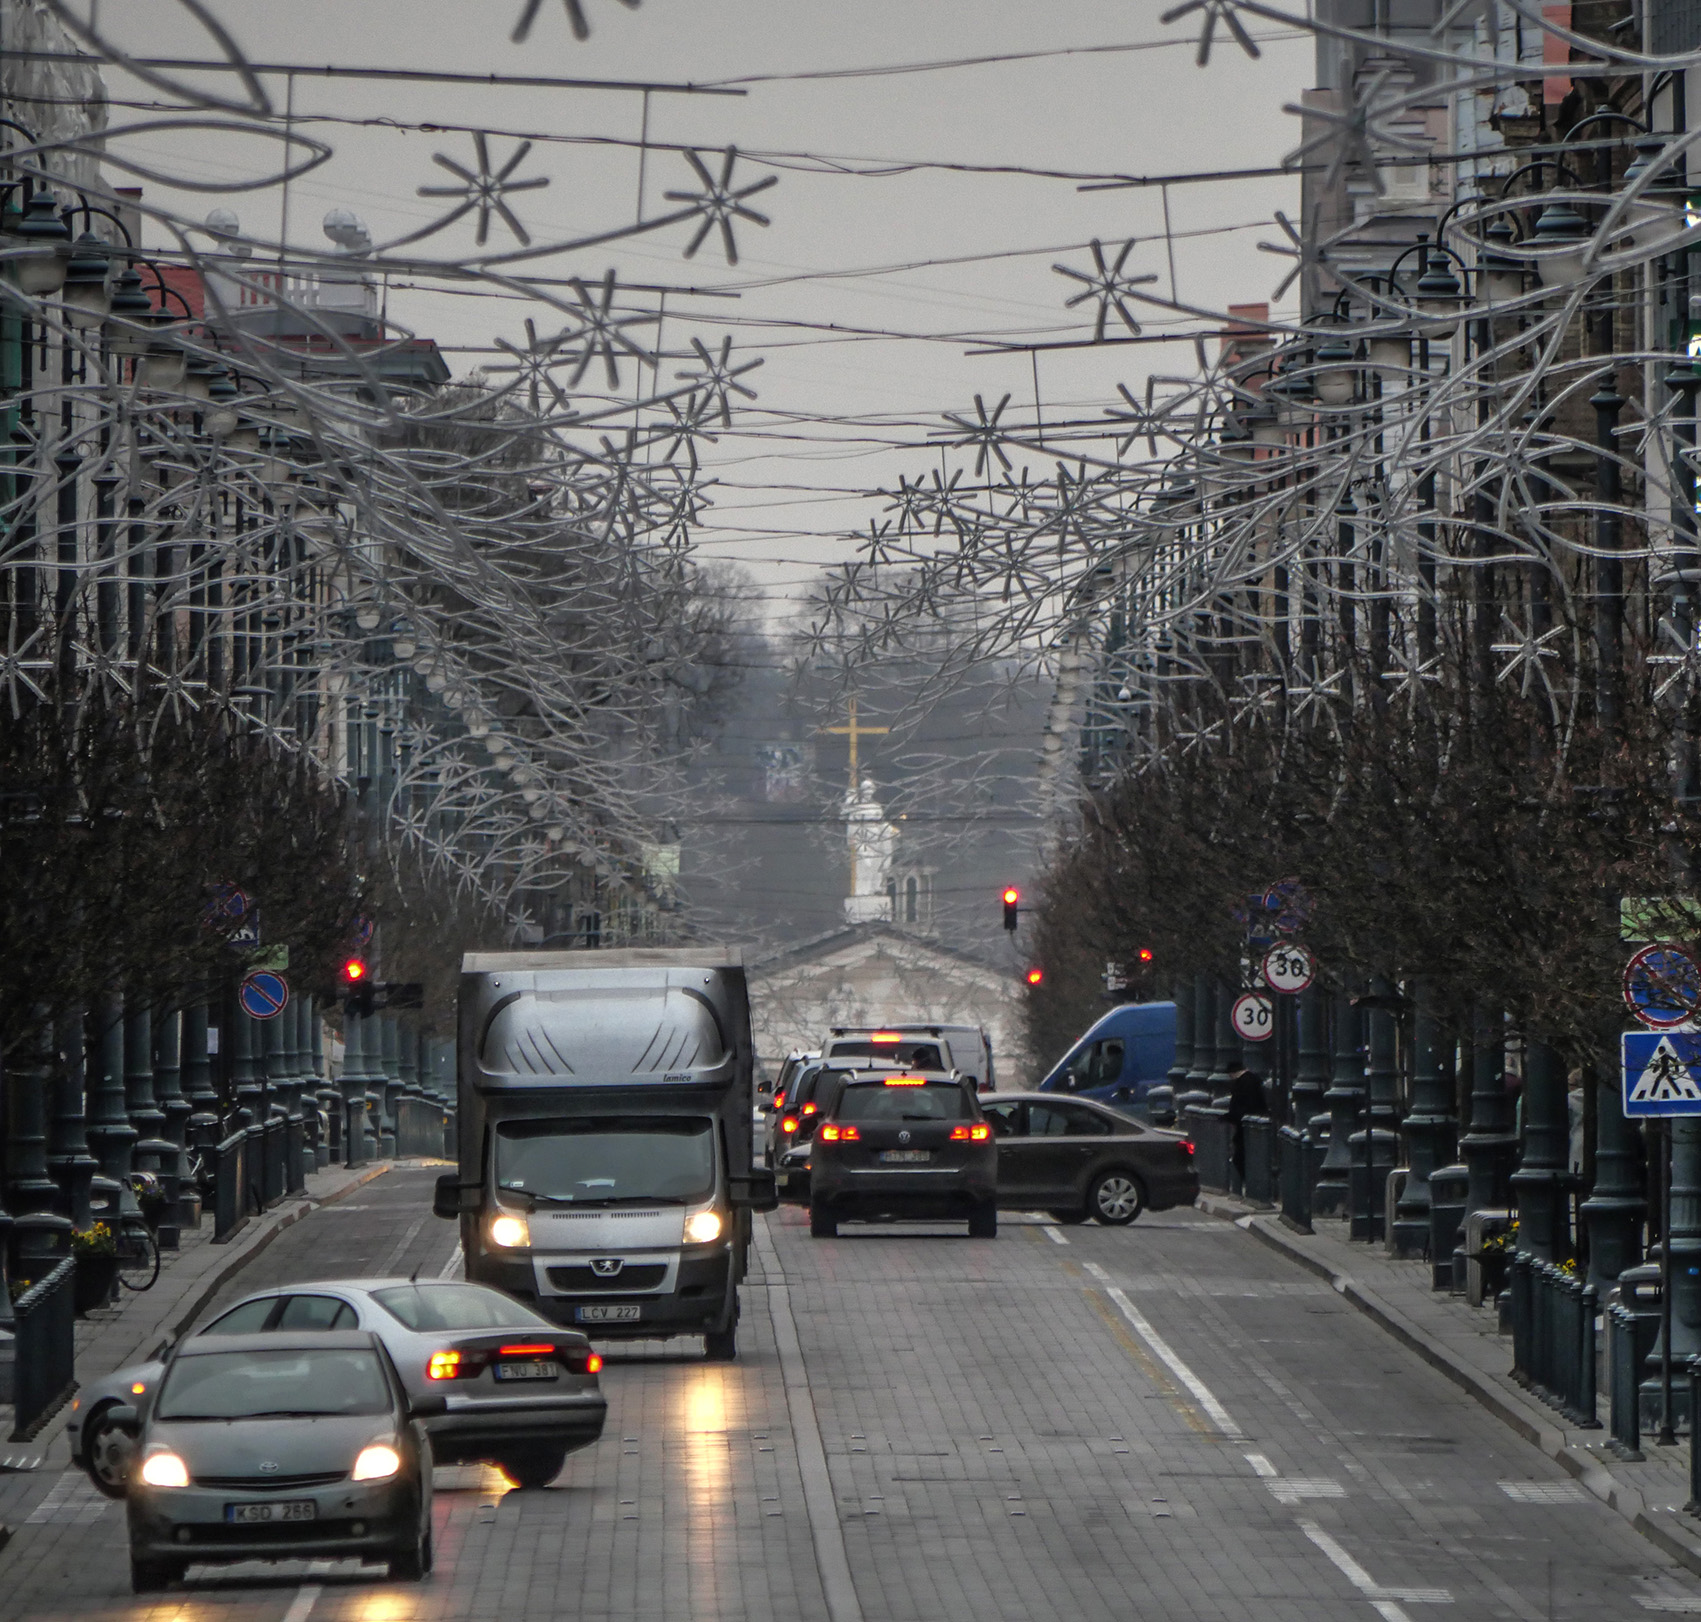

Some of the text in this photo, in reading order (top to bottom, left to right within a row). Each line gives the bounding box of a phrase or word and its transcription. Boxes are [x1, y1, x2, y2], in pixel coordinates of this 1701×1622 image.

[1276, 953, 1303, 977] 30
[1243, 1007, 1268, 1026] 30
[582, 1307, 639, 1319] LCV 227
